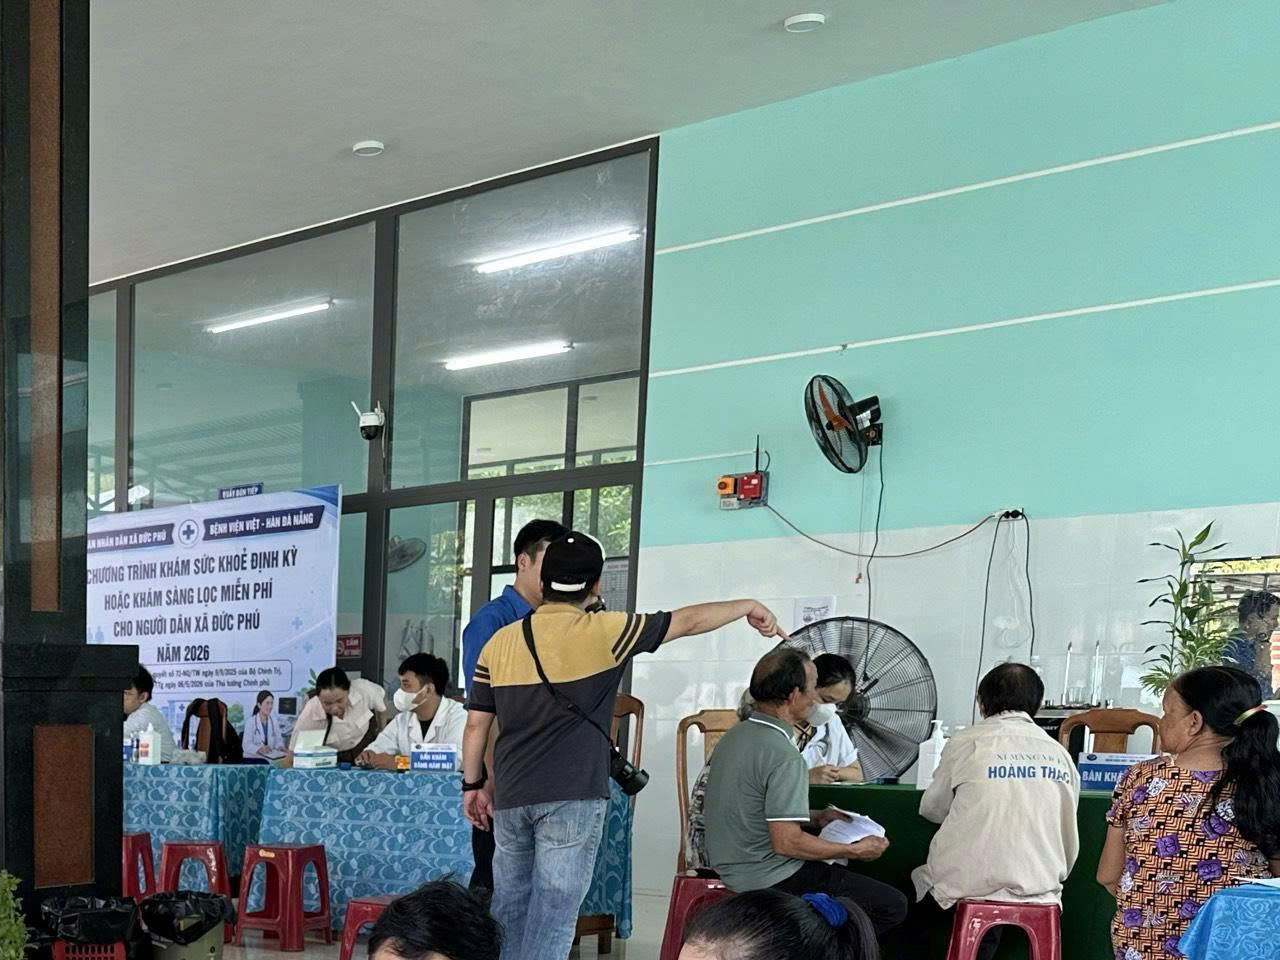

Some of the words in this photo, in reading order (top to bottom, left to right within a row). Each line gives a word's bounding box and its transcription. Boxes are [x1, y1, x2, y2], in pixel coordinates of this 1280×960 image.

[210, 522, 227, 536] BỆNH
[229, 520, 244, 534] VIỆN
[245, 517, 260, 532] VIỆT
[87, 539, 96, 549] AN
[87, 564, 124, 585] CHƯƠNG
[128, 560, 157, 580] TRÌNH
[160, 556, 190, 578] KHÁM
[194, 554, 215, 575] SỨC
[218, 547, 247, 573] KHOẺ
[251, 550, 279, 573] ĐỊNH
[282, 545, 298, 567] KỲ
[104, 592, 130, 613] HOẶC
[133, 588, 163, 609] KHÁM
[165, 585, 194, 606] SÀNG
[197, 586, 217, 607] LỌC
[221, 577, 250, 602] MIỄN
[253, 577, 273, 600] PHÍ
[113, 619, 133, 637] CHO
[135, 614, 167, 636] NGƯỜI
[170, 614, 191, 634] DÂN
[194, 611, 209, 633] XÃ
[212, 610, 234, 632] ĐỨC
[237, 608, 260, 630] PHÚ
[157, 643, 181, 663] NĂM
[184, 644, 210, 662] 2026
[988, 763, 1036, 779] HOÀNG
[1082, 769, 1102, 782] BÀN
[1104, 771, 1121, 782] KH
